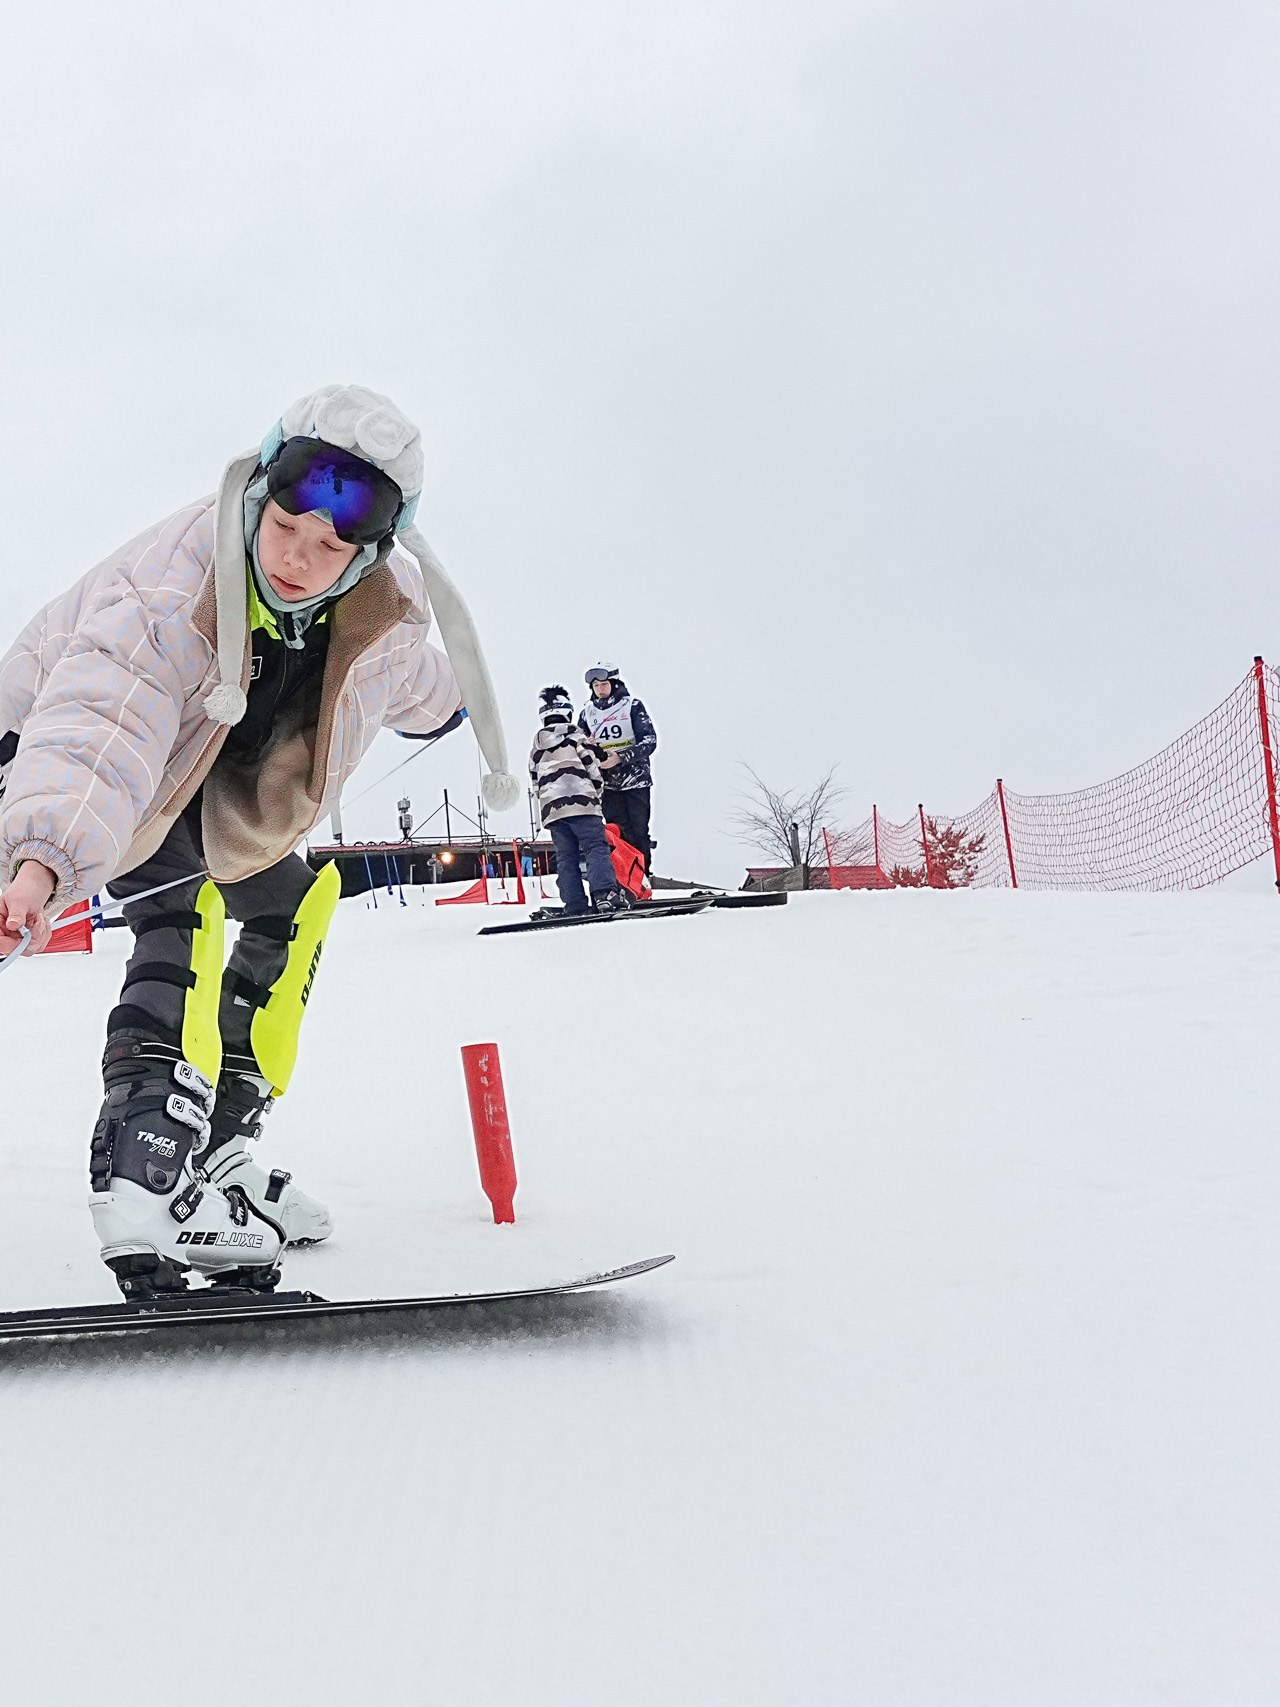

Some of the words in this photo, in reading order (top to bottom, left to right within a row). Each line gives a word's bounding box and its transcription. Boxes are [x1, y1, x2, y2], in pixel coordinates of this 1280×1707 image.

[599, 725, 622, 740] 49
[301, 950, 320, 1007] UFO
[136, 1131, 178, 1150] TRACK
[149, 1144, 176, 1158] 700
[175, 1231, 263, 1248] DEELUXE
